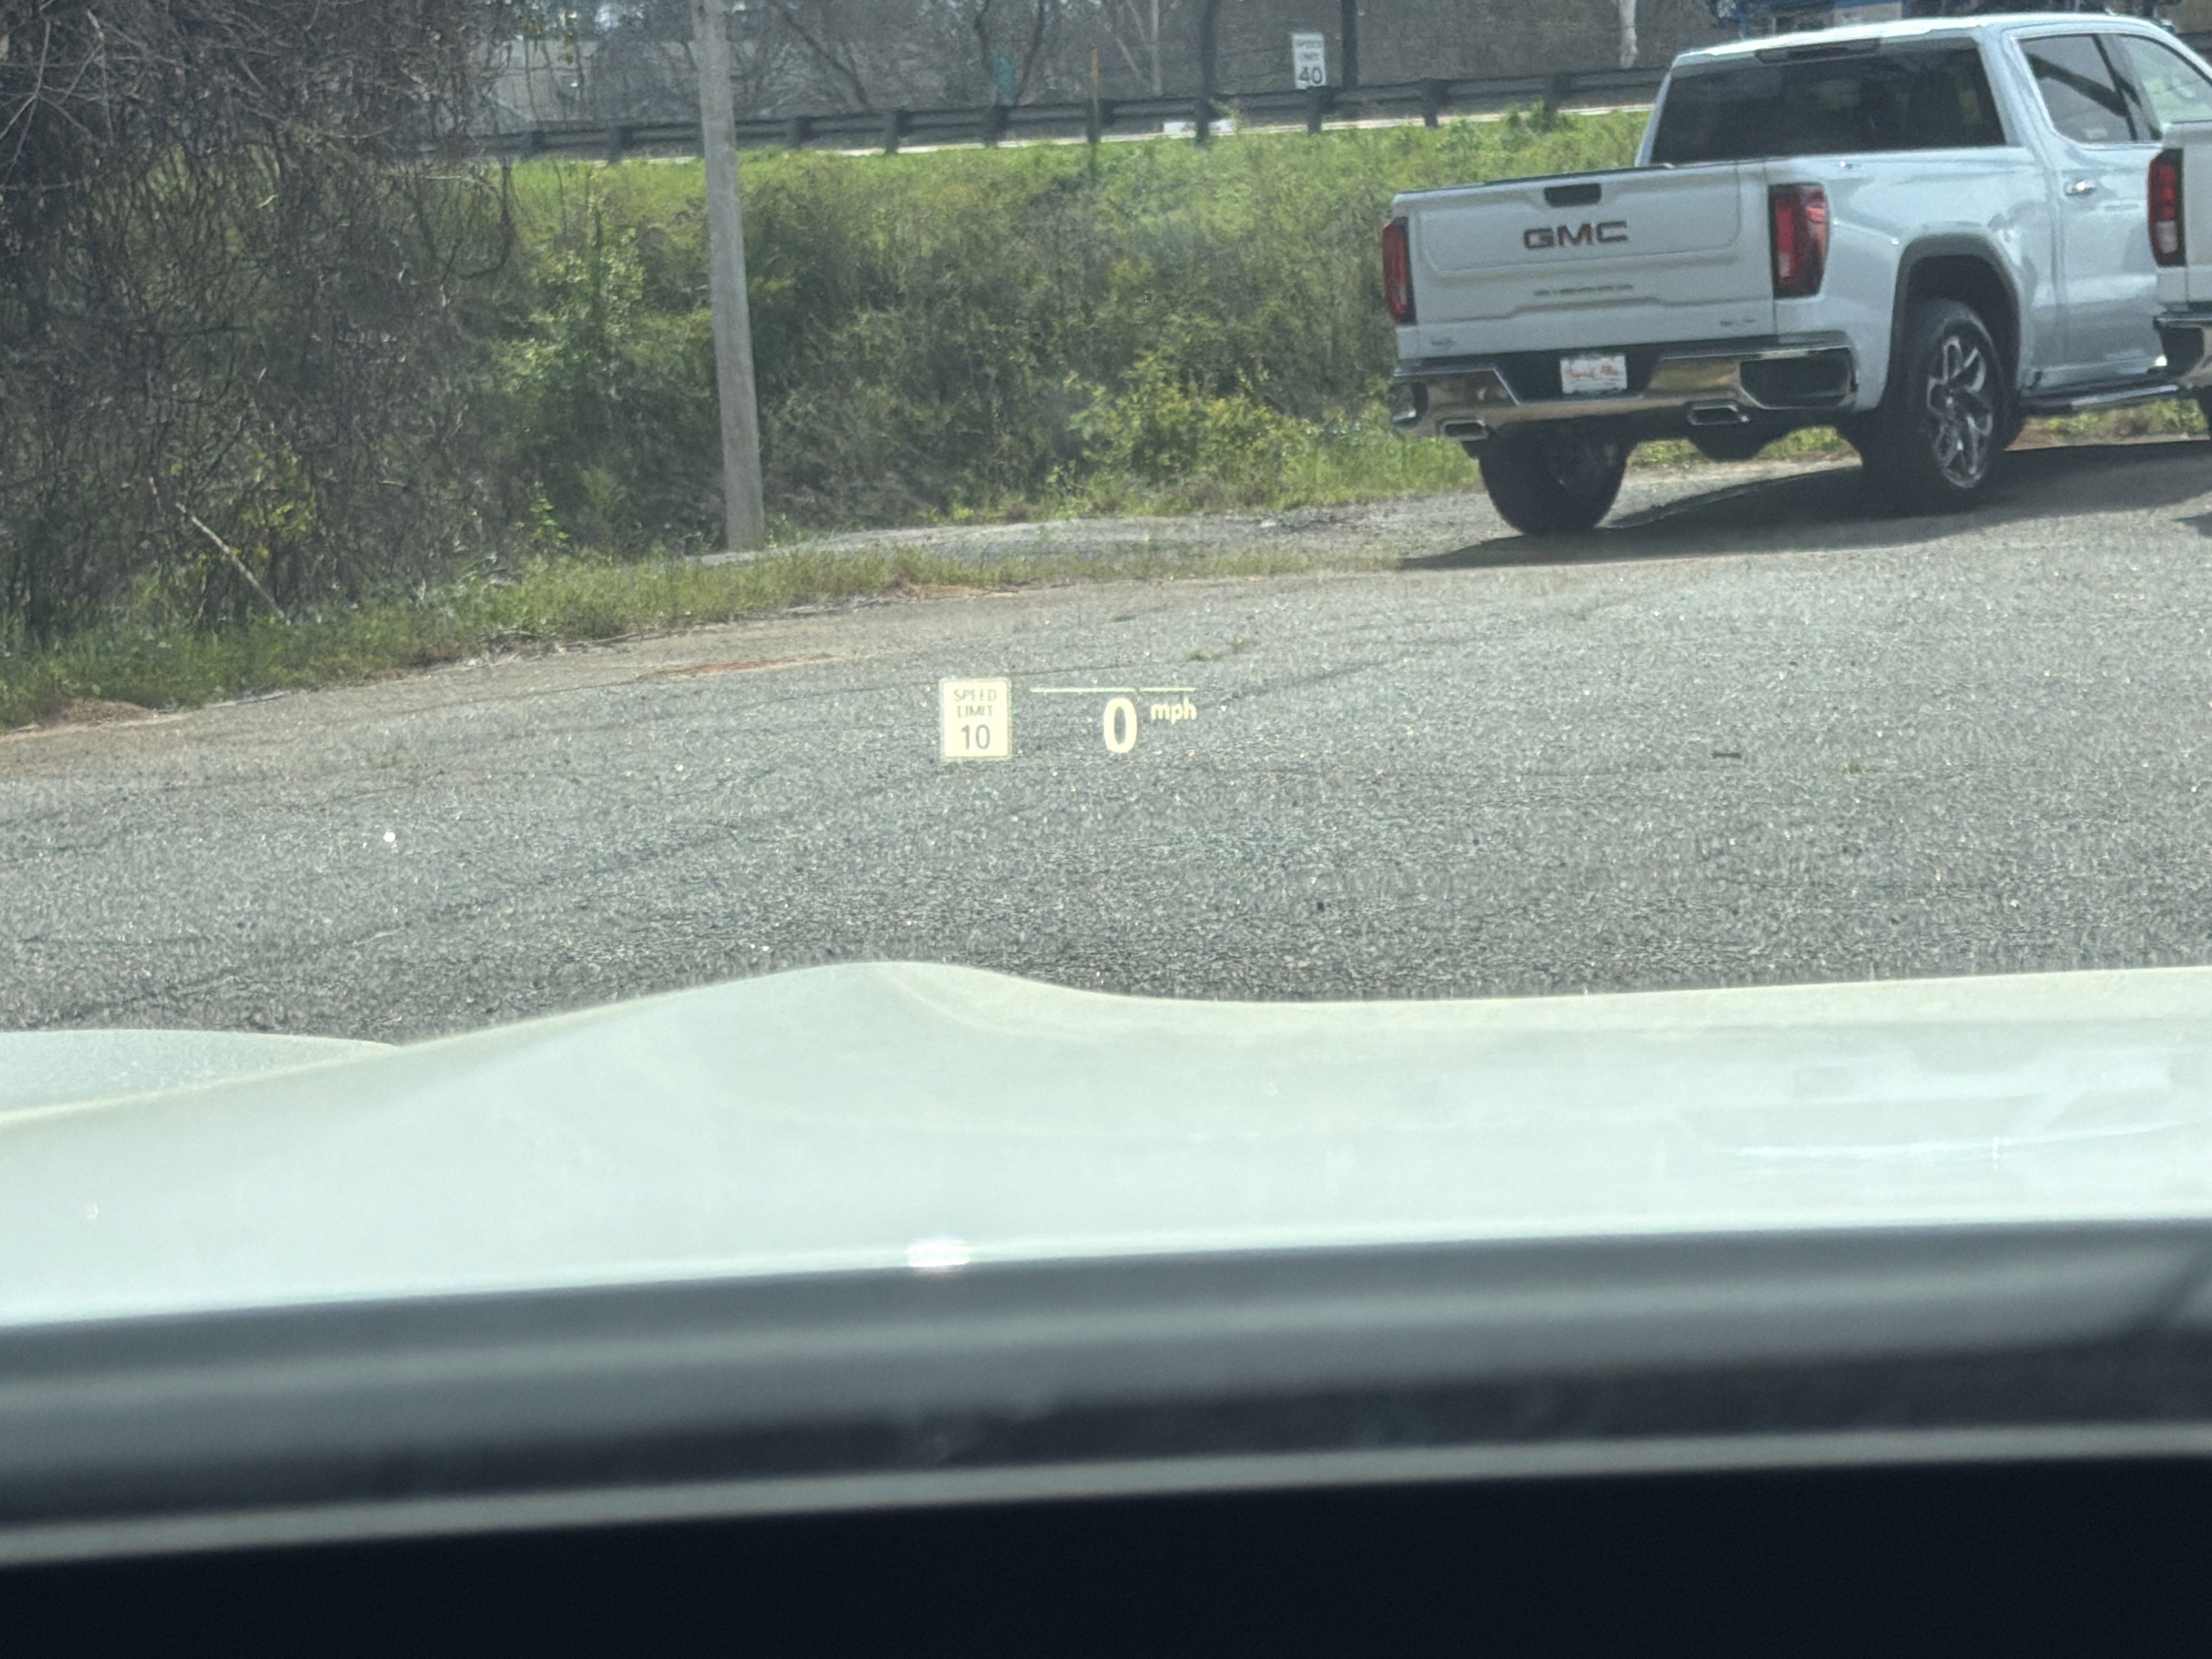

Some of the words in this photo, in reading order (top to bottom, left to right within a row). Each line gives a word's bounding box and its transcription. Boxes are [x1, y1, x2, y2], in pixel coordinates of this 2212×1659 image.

[1299, 66, 1323, 84] 40
[1523, 221, 1629, 249] GMC
[953, 689, 997, 702] SPEED
[957, 705, 994, 718] LIMIT
[1103, 697, 1137, 753] 0
[1150, 697, 1197, 724] mph
[961, 724, 991, 750] 10
